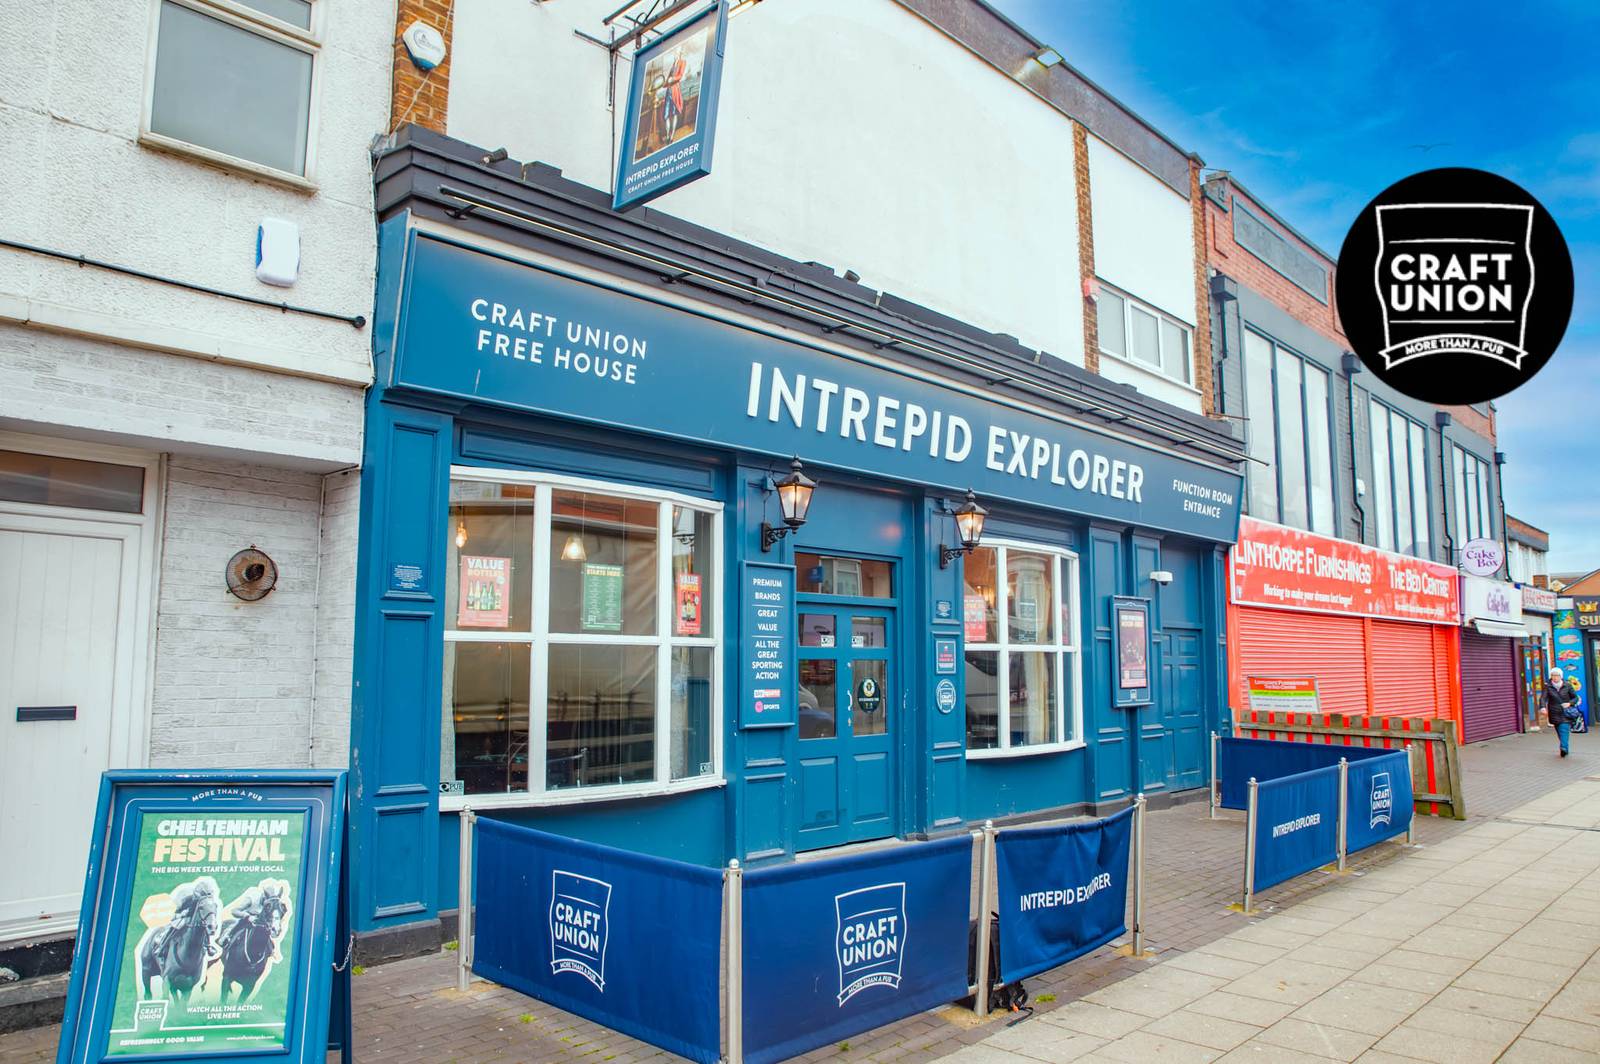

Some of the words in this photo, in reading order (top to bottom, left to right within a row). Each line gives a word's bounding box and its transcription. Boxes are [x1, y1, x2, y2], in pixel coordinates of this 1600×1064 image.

[626, 163, 659, 184] INTREPID
[660, 143, 699, 168] EXPLORER
[627, 182, 643, 193] CRAFT
[644, 175, 660, 186] UNION
[661, 168, 675, 178] FREE
[675, 158, 694, 171] HOUSE
[470, 298, 557, 337] CRAFT
[567, 321, 648, 360] UNION
[477, 329, 544, 364] FREE
[554, 347, 638, 385] HOUSE
[746, 361, 973, 463] INTREPID
[986, 425, 1144, 504] EXPLORER
[1172, 479, 1211, 499] FUNCTION
[1211, 489, 1233, 505] ROOM
[1183, 499, 1221, 518] ENTRANCE
[1466, 549, 1496, 560] Cake
[467, 558, 505, 570] VALUE
[1235, 539, 1305, 575] LINTHORPE
[1305, 546, 1372, 585] FURNISHINGS
[752, 578, 782, 588] PREMIUM
[754, 592, 781, 601] BRANDS
[757, 609, 778, 617] GREAT
[757, 623, 778, 632] VALUE
[755, 640, 766, 649] ALL
[766, 641, 779, 649] THE
[757, 651, 778, 659] GREAT
[752, 661, 783, 670] SPORTING
[755, 671, 779, 680] ACTION
[191, 790, 215, 802] MORE
[247, 791, 263, 802] PUB
[1373, 788, 1390, 801] CRAFT
[1372, 799, 1391, 810] UNION
[157, 819, 289, 836] CHELTENHAM
[1272, 819, 1296, 839] INTREPID
[1295, 813, 1321, 831] EXPLORER
[153, 837, 286, 863] FESTIVAL
[151, 866, 166, 874] THE
[202, 865, 228, 873] STARTS
[1020, 888, 1075, 912] INTREPID
[555, 902, 601, 932] CRAFT
[554, 921, 599, 953] UNION
[843, 915, 898, 945] CRAFT
[843, 935, 897, 967] UNION
[847, 979, 863, 995] MORE
[139, 1006, 163, 1014] CRAFT
[187, 1005, 210, 1013] WATCH
[210, 1005, 223, 1013] ALL
[237, 1004, 263, 1012] ACTION
[139, 1012, 162, 1020] UNION
